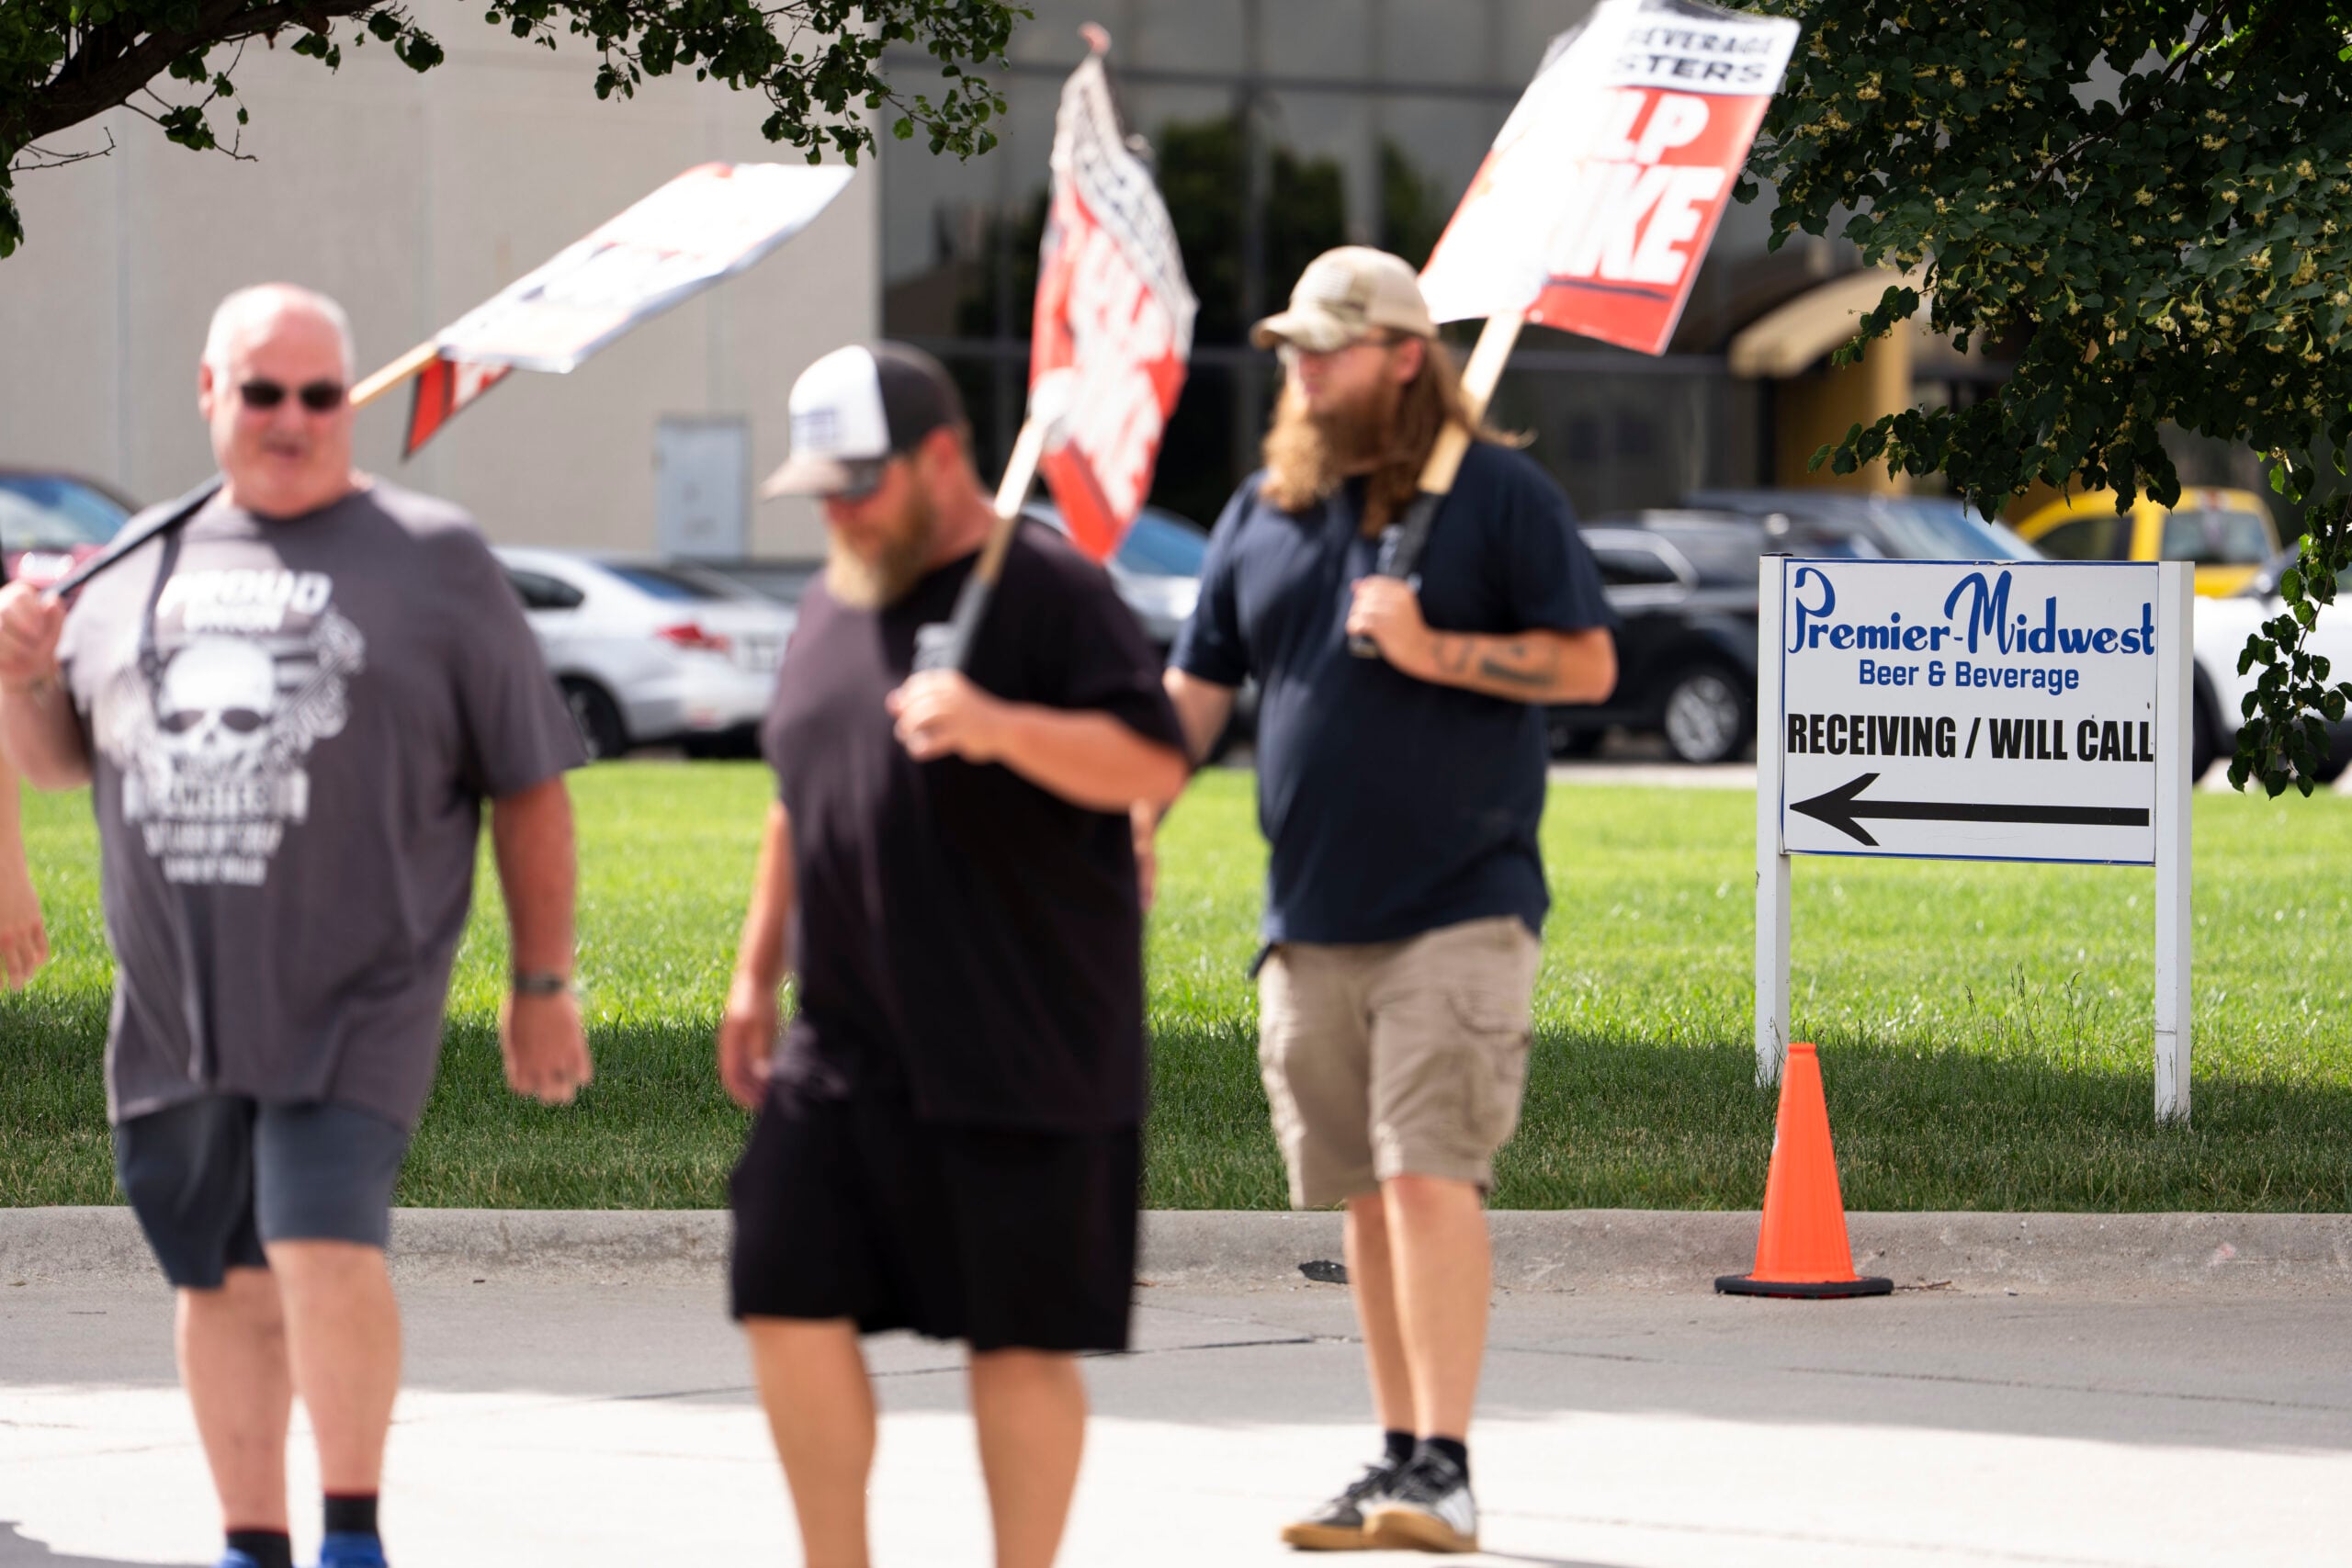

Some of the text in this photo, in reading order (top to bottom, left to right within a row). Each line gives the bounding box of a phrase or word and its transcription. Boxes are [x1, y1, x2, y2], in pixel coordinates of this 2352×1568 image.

[1788, 567, 2154, 655] Premier-Midwest
[1859, 659, 2080, 695] Beer & Beverage
[1788, 714, 2154, 763] RECEIVING / WILL CALL
